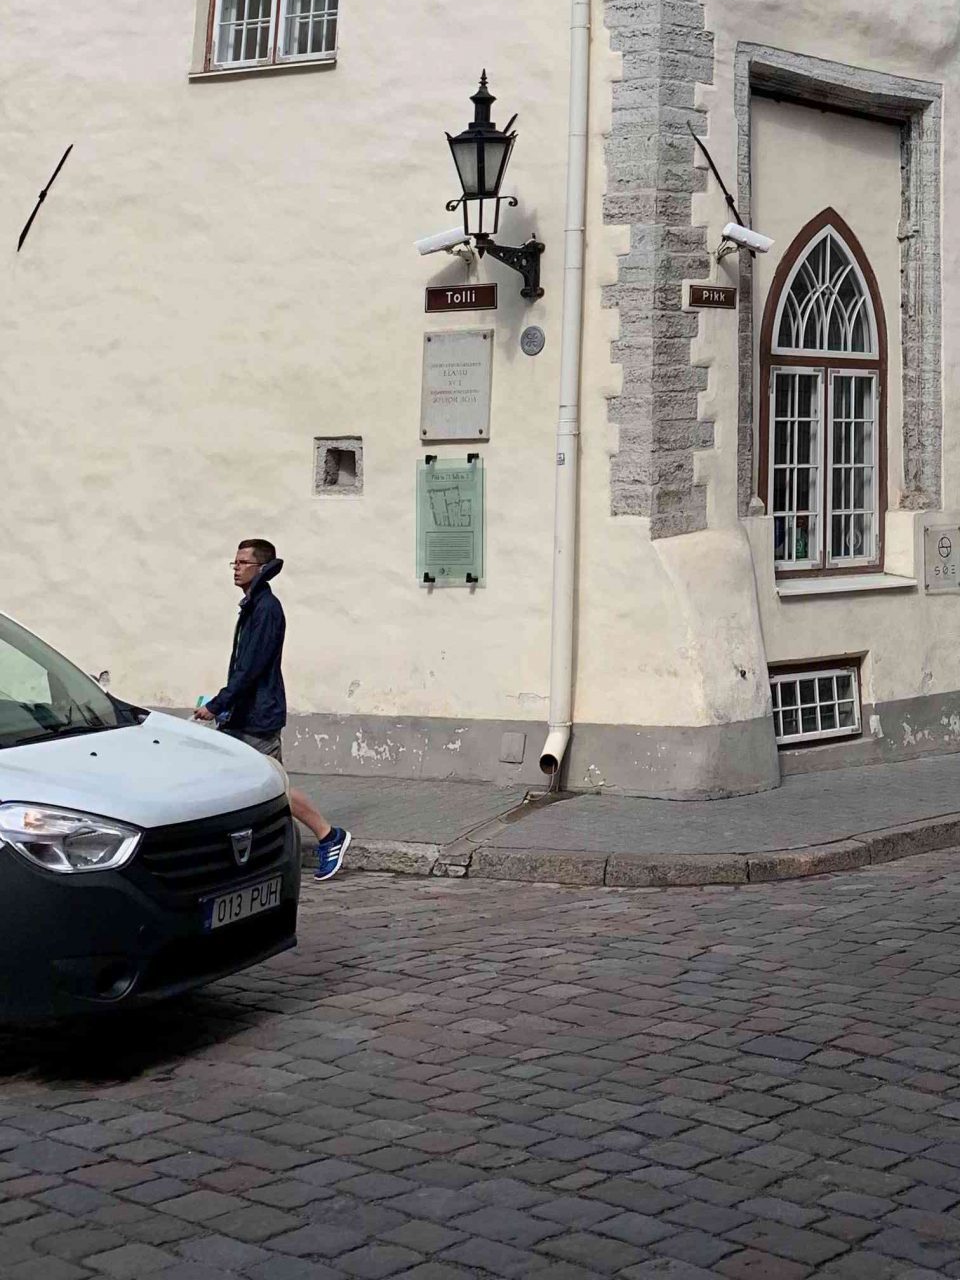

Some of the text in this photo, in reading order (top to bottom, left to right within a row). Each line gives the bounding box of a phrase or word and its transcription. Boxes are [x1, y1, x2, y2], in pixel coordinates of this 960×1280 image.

[446, 290, 476, 304] Tolli
[702, 290, 726, 302] Pikk
[218, 879, 279, 923] 013 PUH
